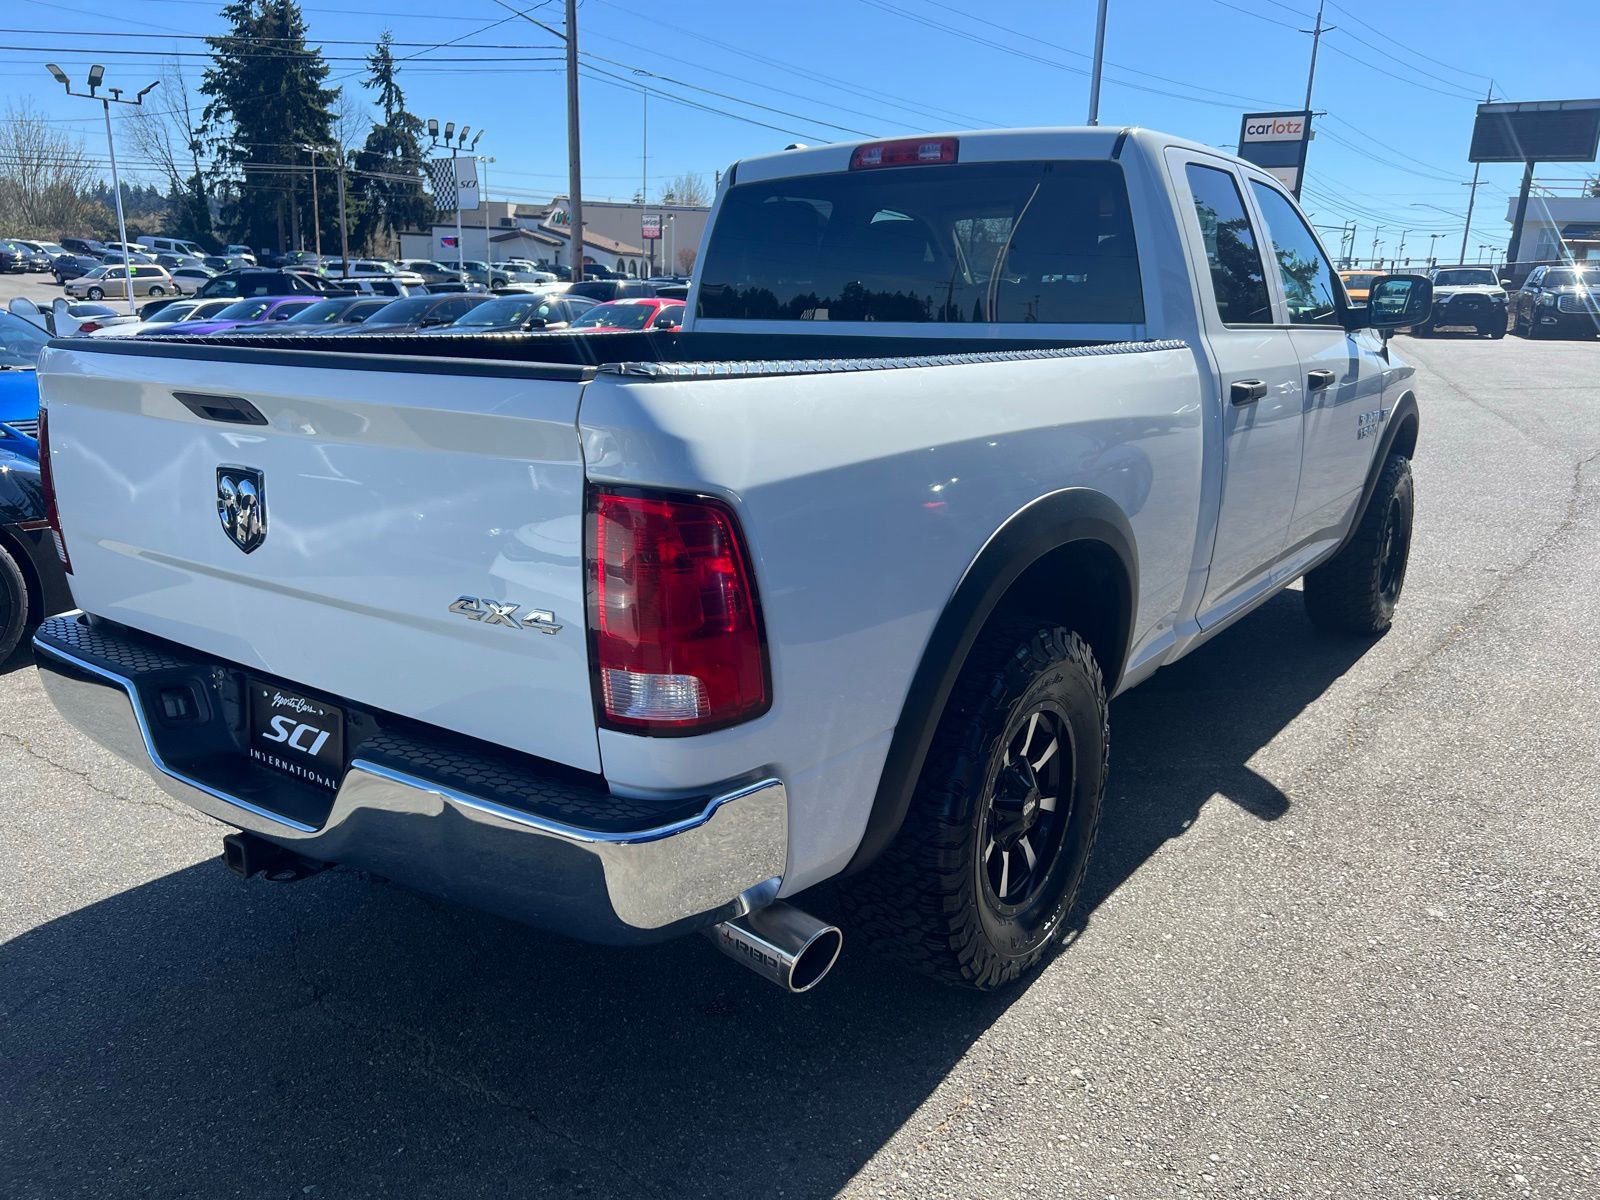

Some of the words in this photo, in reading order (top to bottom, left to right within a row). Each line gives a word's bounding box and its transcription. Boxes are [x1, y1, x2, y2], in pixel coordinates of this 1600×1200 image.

[1247, 120, 1301, 135] carlotz
[460, 180, 477, 188] SCI
[296, 698, 316, 713] Cars
[262, 715, 330, 755] SCI
[250, 748, 337, 789] INTERNATIONAL
